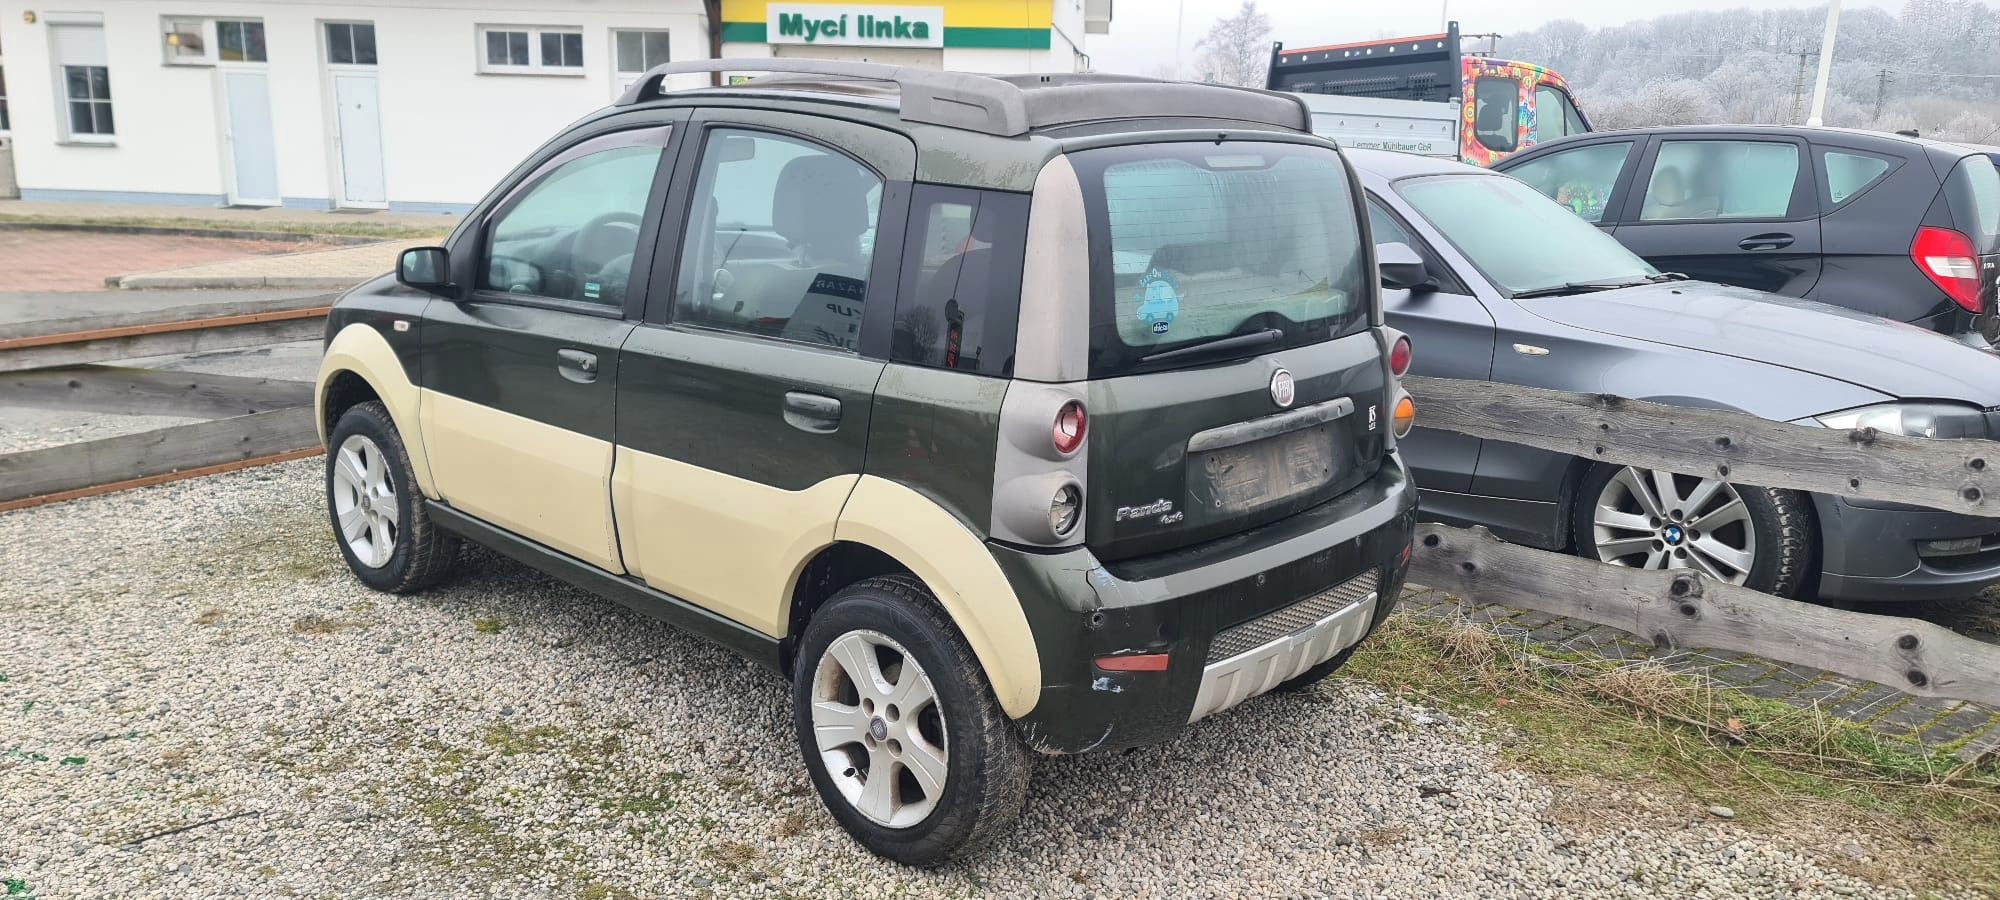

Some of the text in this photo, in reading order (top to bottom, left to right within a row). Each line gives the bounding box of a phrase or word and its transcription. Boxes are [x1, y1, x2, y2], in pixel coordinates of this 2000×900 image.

[778, 13, 930, 42] Mycí linka
[1116, 499, 1173, 521] Panda
